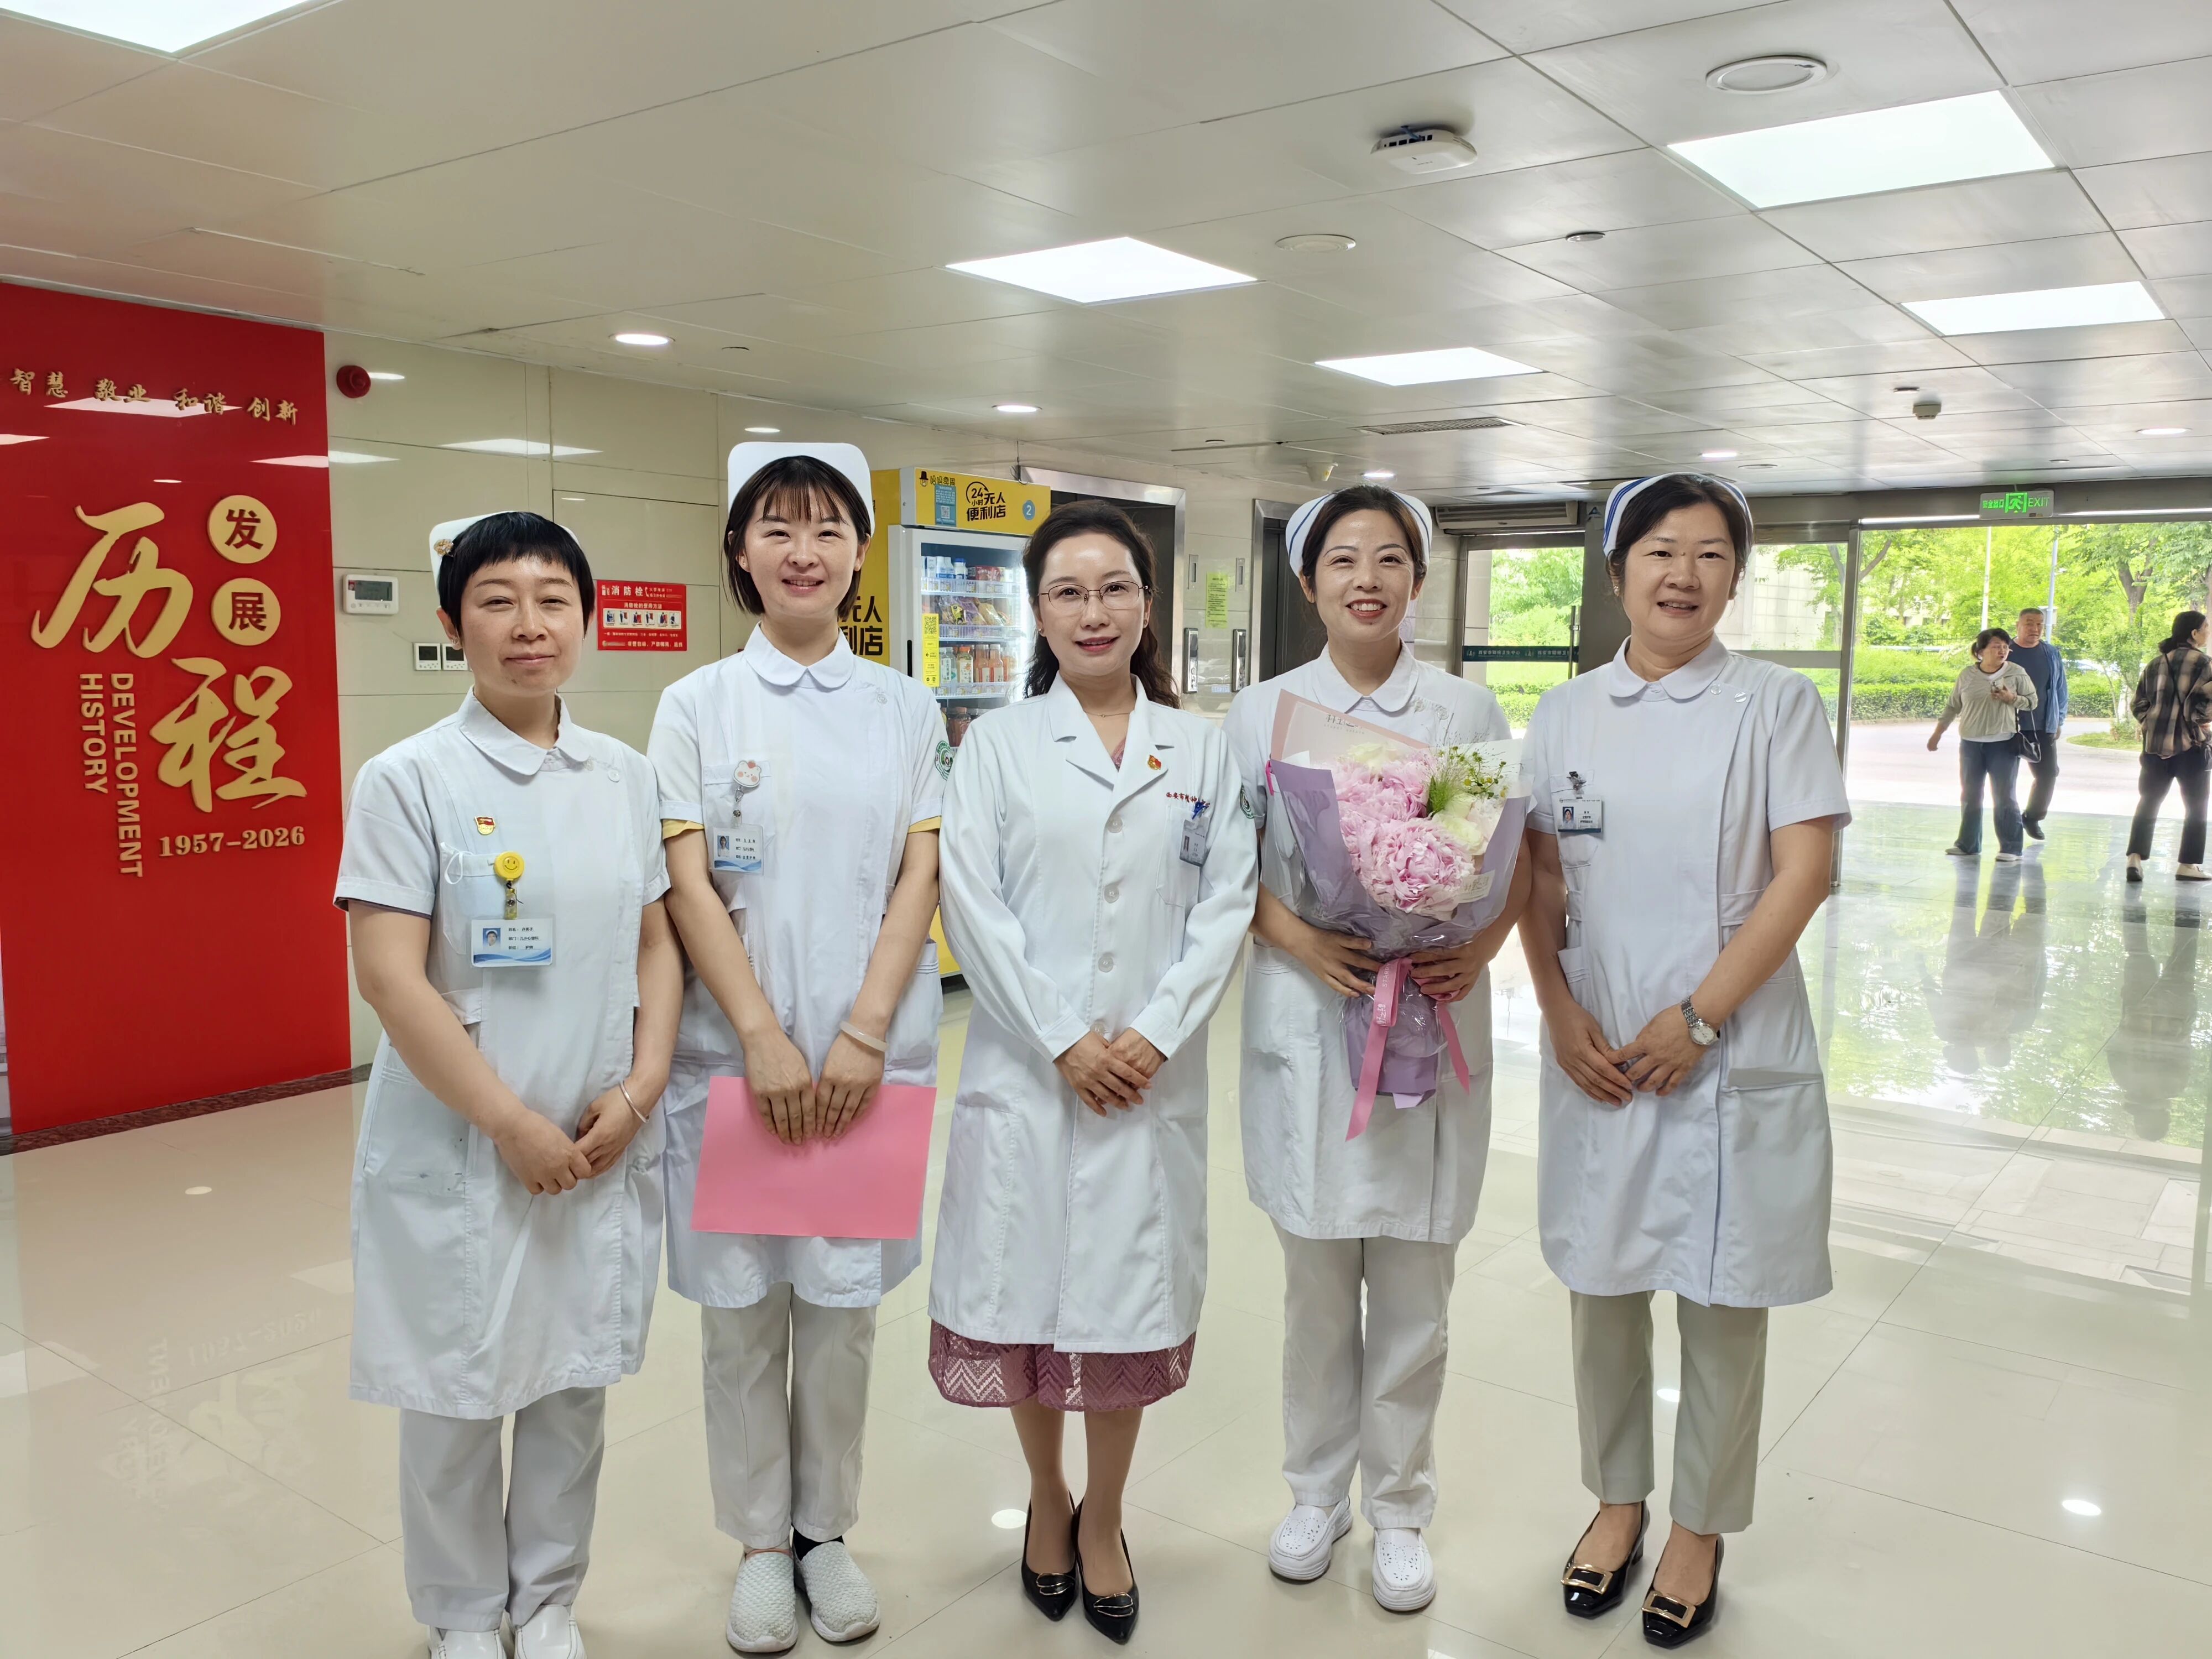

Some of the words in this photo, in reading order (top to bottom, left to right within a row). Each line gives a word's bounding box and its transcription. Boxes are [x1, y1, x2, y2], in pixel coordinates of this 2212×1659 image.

[10, 368, 69, 398] 智慧
[93, 378, 152, 403] 敬业
[173, 388, 227, 415] 和谐
[246, 398, 299, 425] 创新
[971, 488, 983, 498] 24
[984, 492, 1006, 505] 无人
[1026, 504, 1031, 515] 2
[2028, 497, 2050, 507] EXIT
[966, 504, 1006, 521] 便利店
[612, 585, 644, 597] 消防栓
[79, 673, 108, 794] HISTORY
[111, 672, 143, 877] DEVELOPMENT
[159, 826, 305, 857] 1957-2026
